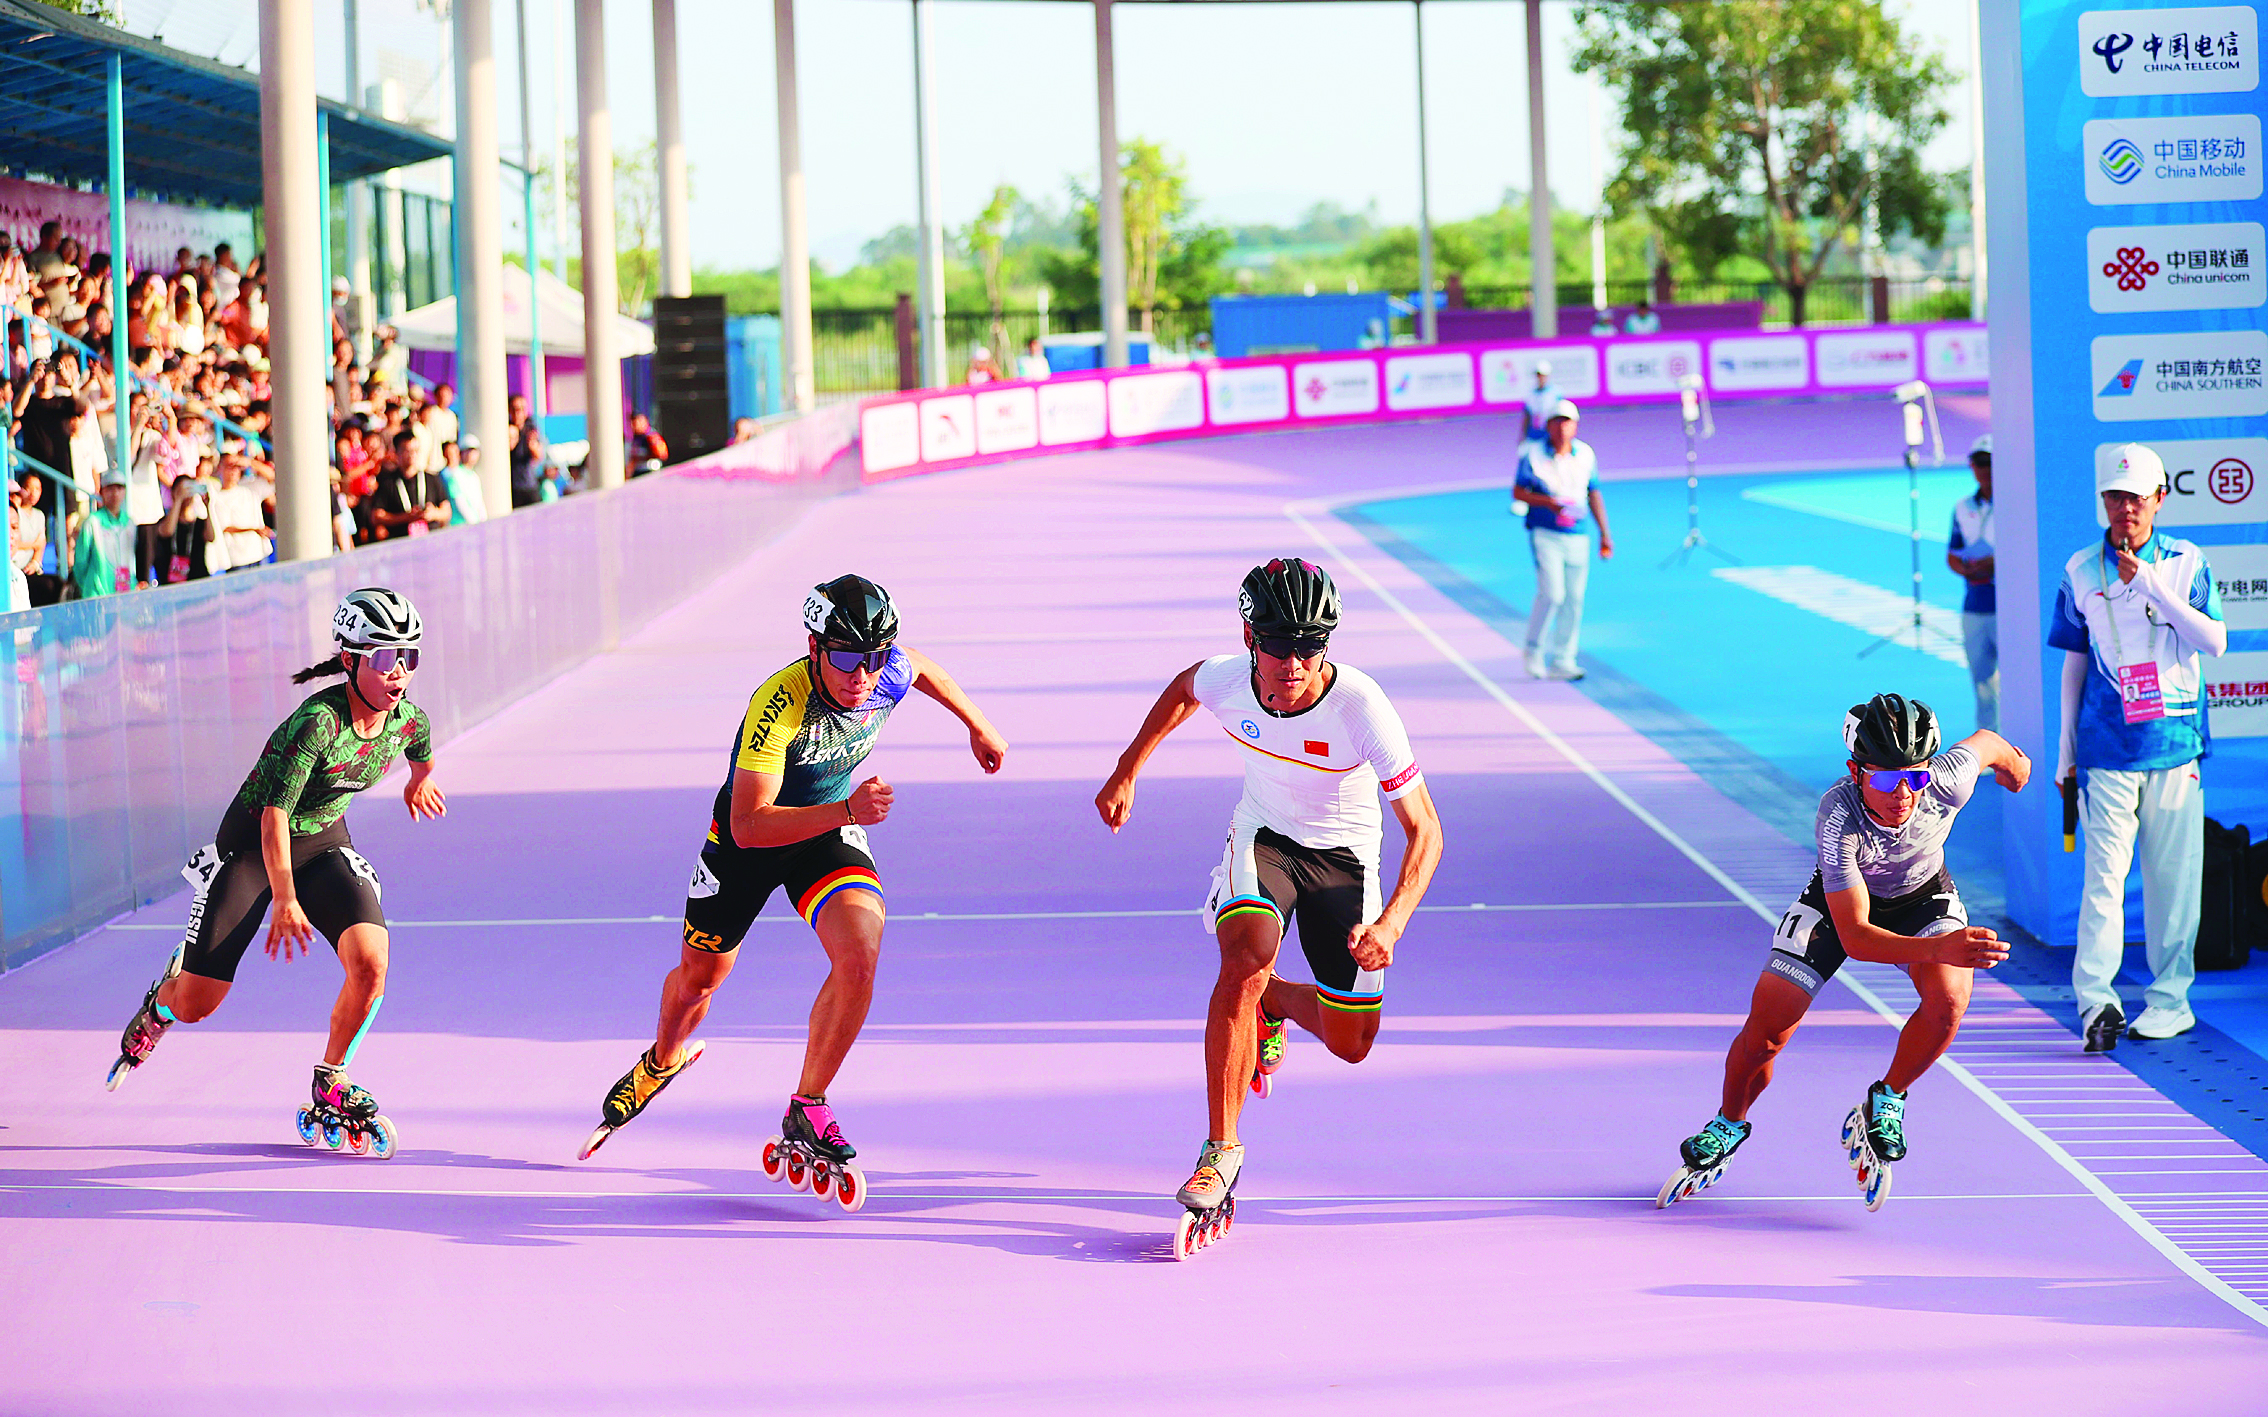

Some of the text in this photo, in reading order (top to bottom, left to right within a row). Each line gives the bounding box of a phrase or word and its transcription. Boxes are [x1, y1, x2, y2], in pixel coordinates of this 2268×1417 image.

[2143, 31, 2238, 62] 中国电信
[2143, 60, 2240, 73] CHINA TELECOM
[2154, 136, 2245, 162] 中国移动
[2155, 161, 2246, 179] China Mobile
[2167, 249, 2249, 269] 中国联通
[2167, 272, 2250, 285] China unicom
[2156, 357, 2262, 378] 中国南方航空
[2156, 376, 2263, 392] CHINA SOUTHERN
[1770, 958, 1817, 990] GUANGDONG
